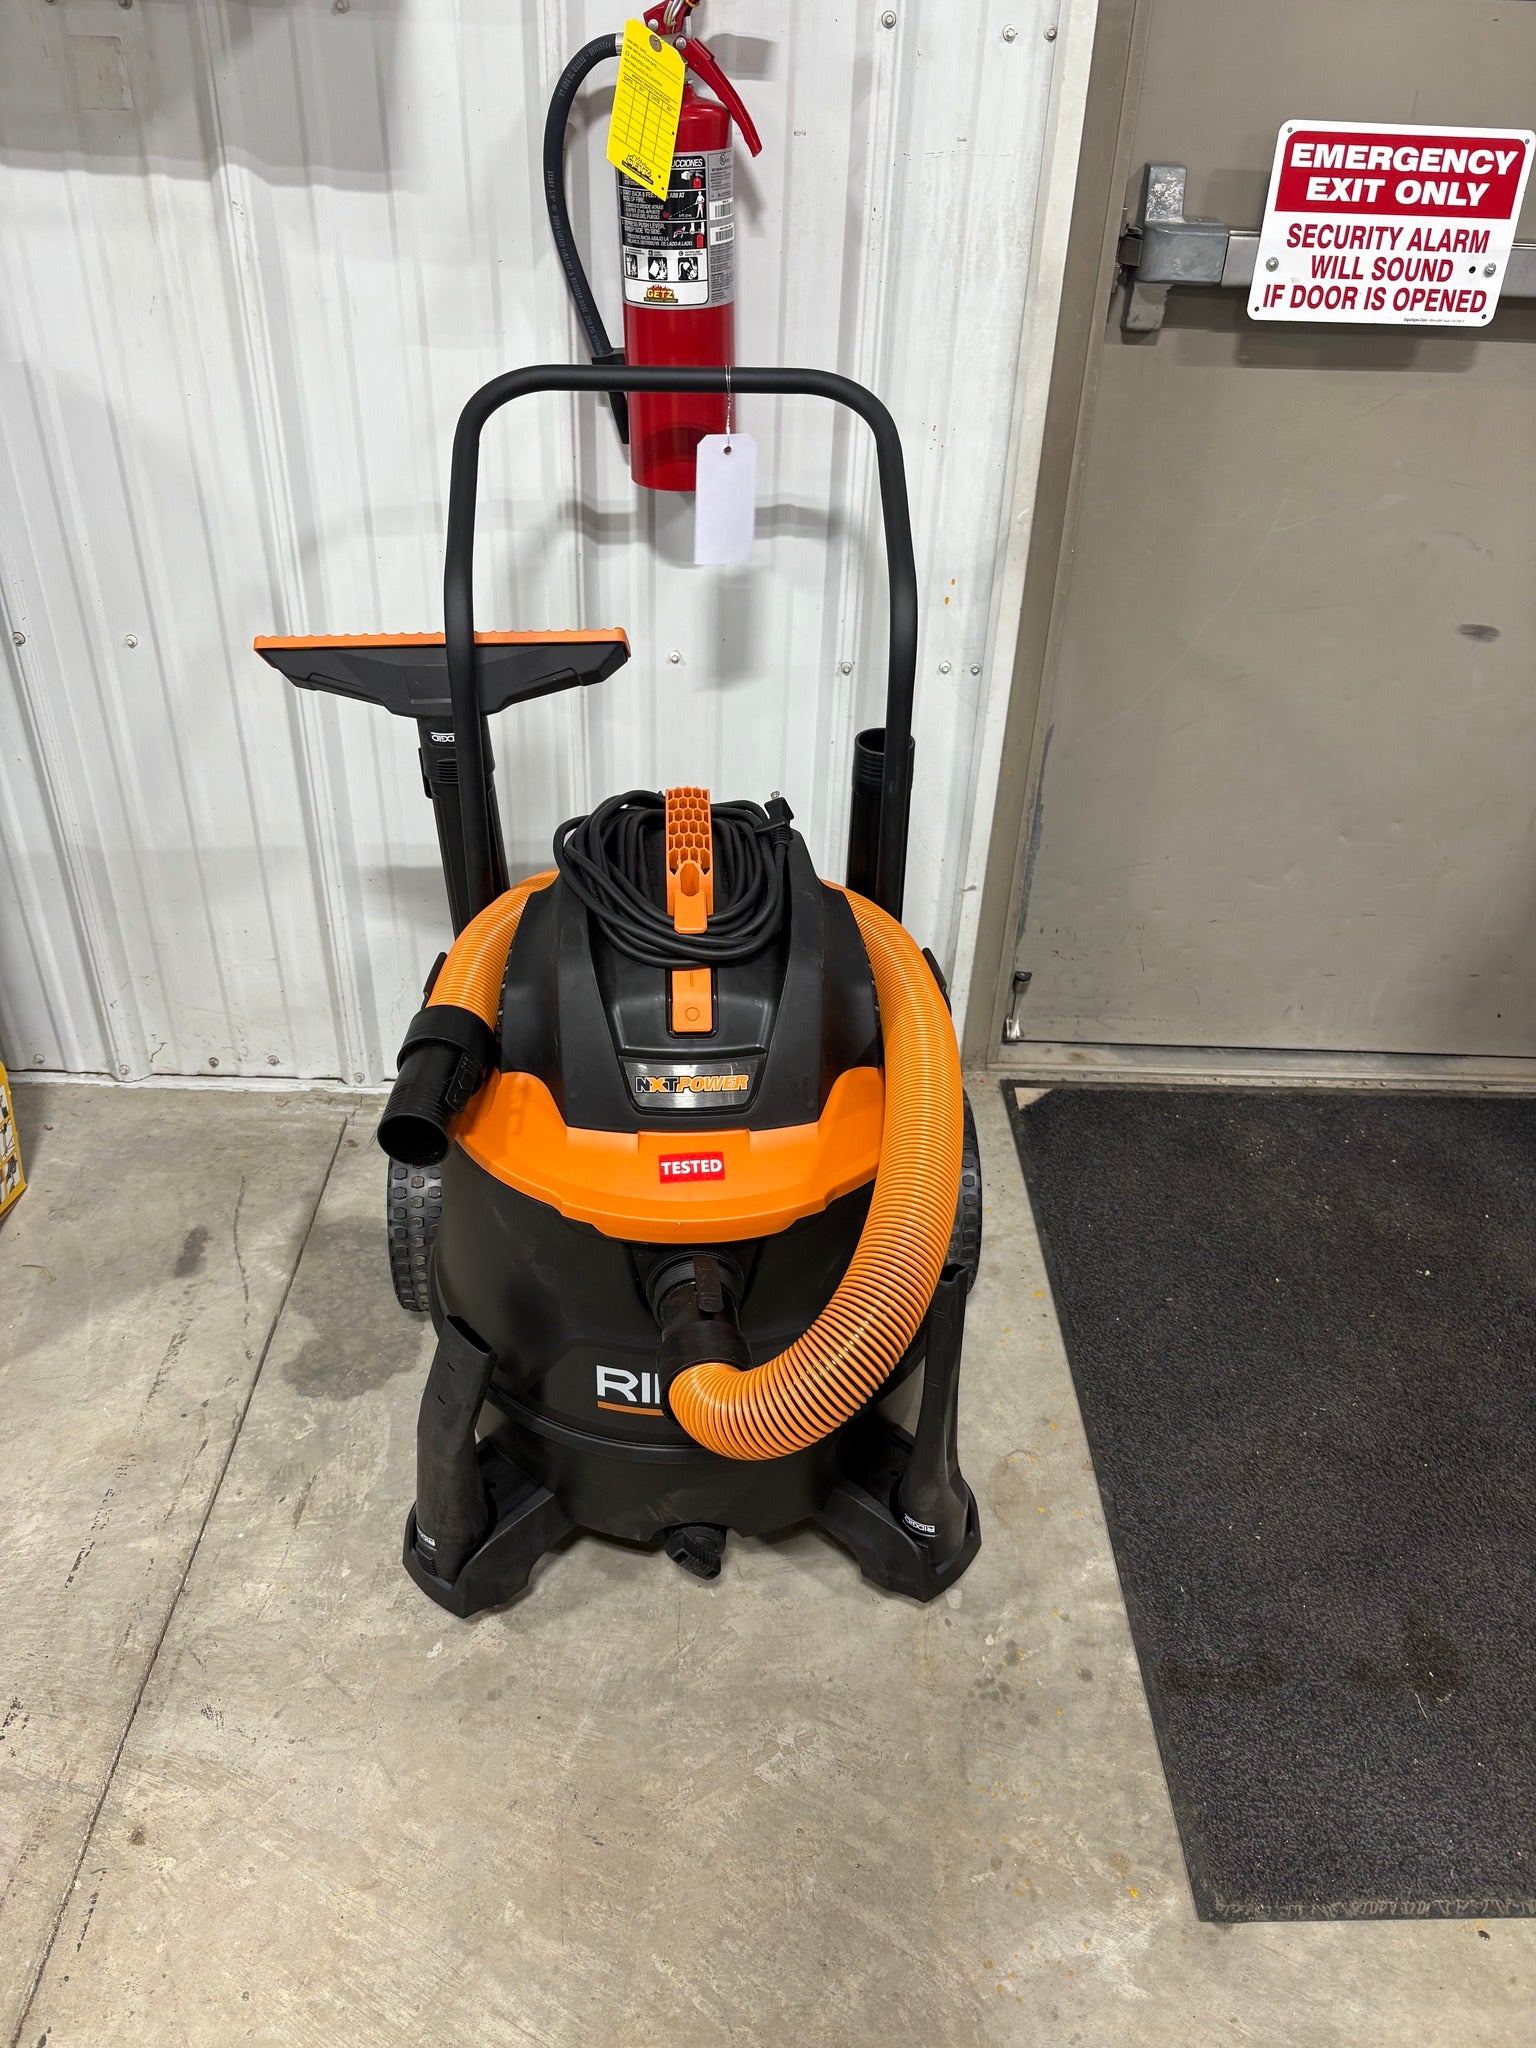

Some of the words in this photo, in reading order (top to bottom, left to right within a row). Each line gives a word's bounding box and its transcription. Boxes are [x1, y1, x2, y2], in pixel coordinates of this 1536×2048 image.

[1290, 142, 1519, 176] EMERGENCY
[1306, 177, 1385, 203] EXIT
[1395, 179, 1490, 206] ONLY
[1286, 223, 1404, 251] SECURITY
[1406, 228, 1490, 254] ALARM
[1311, 255, 1364, 280] WILL
[1371, 257, 1454, 282] SOUND
[647, 289, 673, 298] GETZ
[1262, 284, 1285, 308] IF
[1290, 285, 1358, 310] DOOR
[1364, 287, 1386, 311] IS
[1393, 288, 1487, 313] OPENED
[635, 1075, 749, 1093] NXTPOWER
[661, 1160, 722, 1175] TESTED
[596, 1364, 660, 1404] RI
